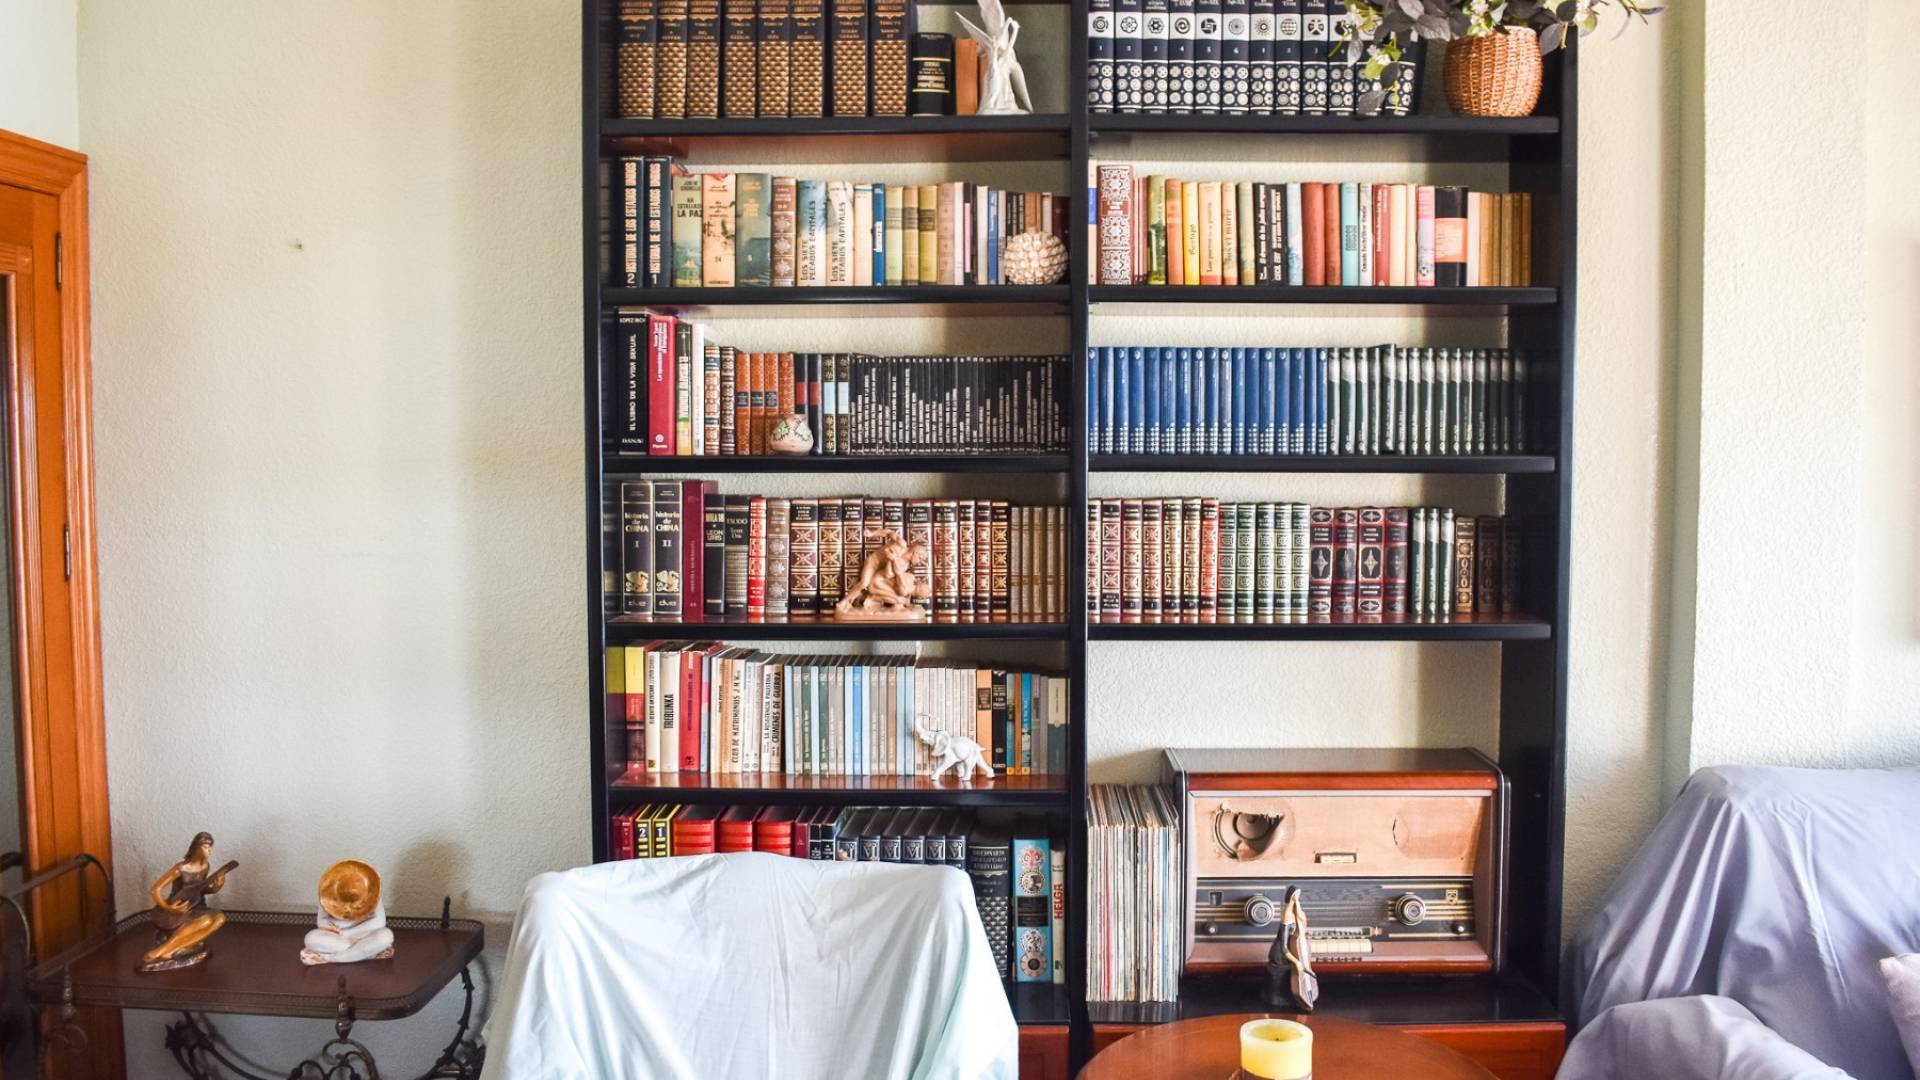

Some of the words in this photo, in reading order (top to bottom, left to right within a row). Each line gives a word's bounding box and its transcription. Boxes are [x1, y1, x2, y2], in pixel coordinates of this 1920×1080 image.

[625, 162, 637, 186] UNIDOS
[649, 163, 661, 187] UNIDOS
[625, 188, 637, 217] ESTADOS
[649, 188, 661, 218] ESTADOS
[677, 210, 686, 218] LA
[689, 210, 703, 218] PAZ
[625, 219, 637, 232] LOS
[649, 220, 661, 232] LOS
[625, 233, 637, 242] DE
[649, 233, 661, 242] DE
[625, 243, 637, 273] HISTORIA
[649, 244, 661, 274] HISTORIA
[626, 273, 636, 285] 2
[651, 274, 658, 285] 1
[629, 334, 637, 360] SEXUAL
[629, 362, 637, 378] VIDA
[629, 380, 637, 388] LA
[629, 390, 637, 400] DE
[629, 402, 637, 422] LIBRO
[629, 423, 637, 431] EL
[624, 512, 649, 520] historia
[656, 524, 679, 532] CHINA
[772, 672, 781, 697] GUERRA
[664, 694, 674, 729] TREBLINKA
[772, 701, 780, 710] DE
[732, 696, 740, 736] MATRIMONIOS
[772, 711, 780, 744] CRIMENES
[732, 738, 739, 747] DE
[640, 828, 646, 836] 2
[657, 828, 663, 837] 1
[1054, 884, 1064, 920] HELGA
